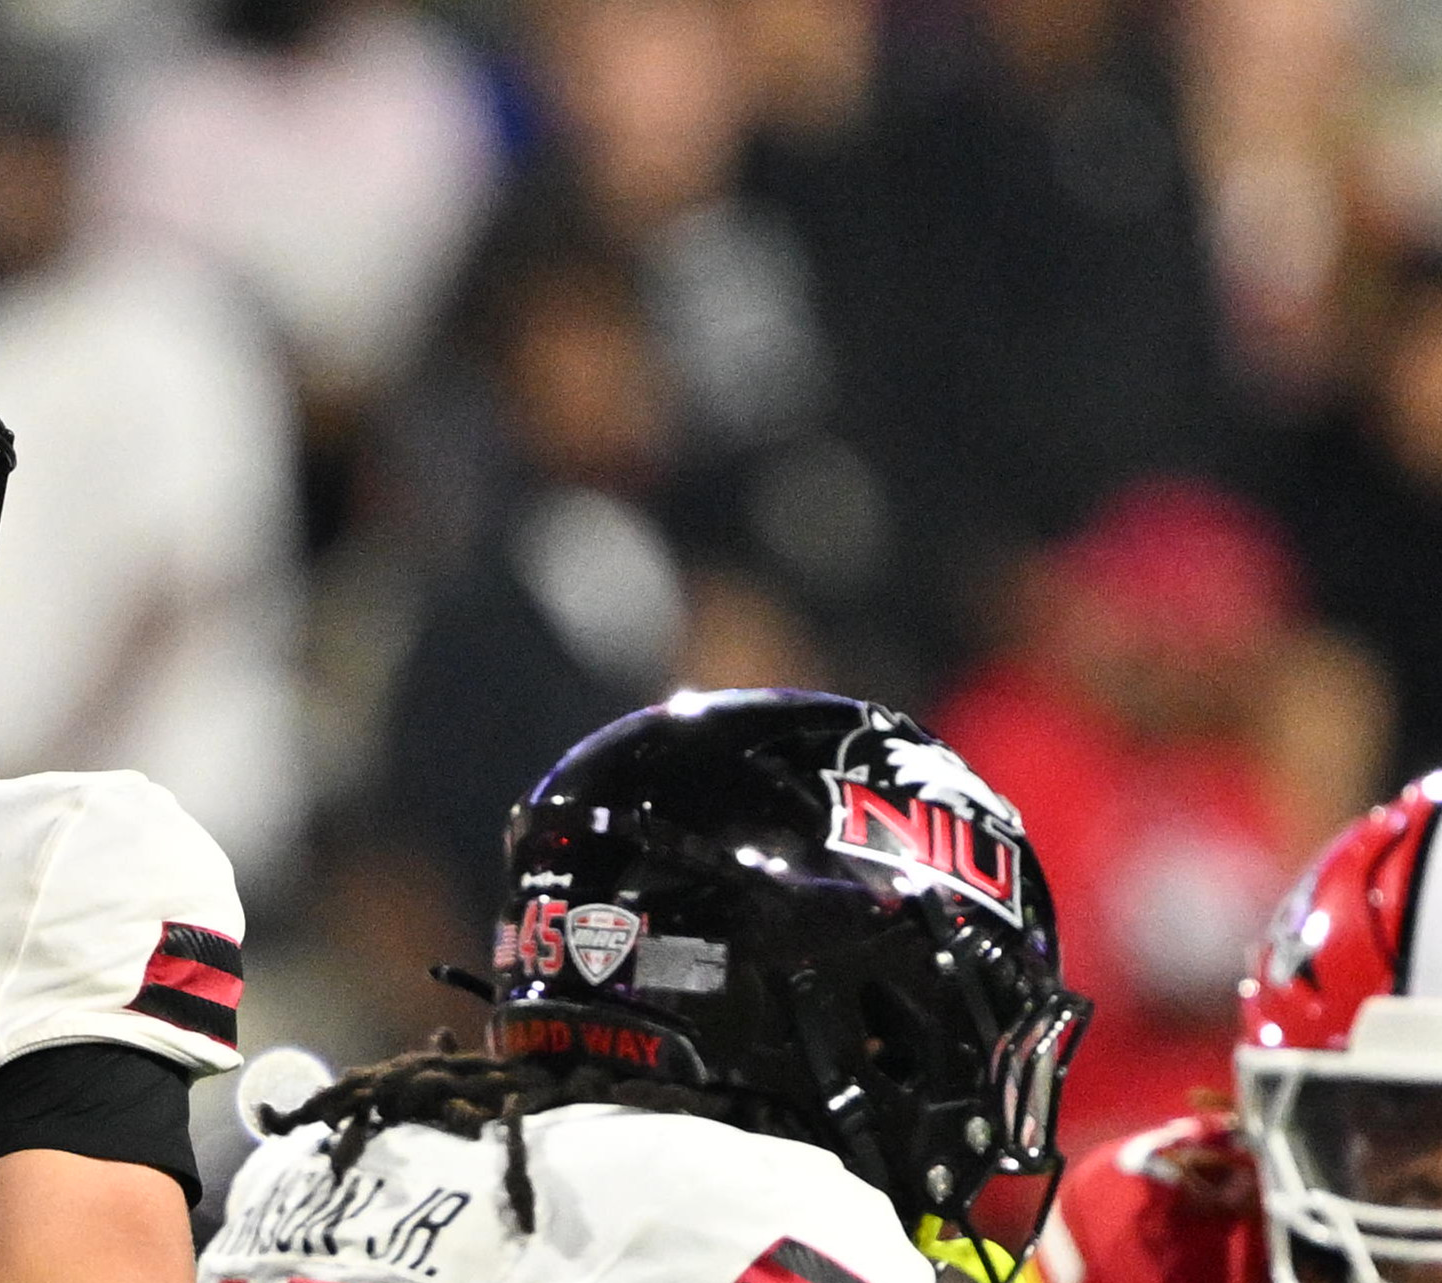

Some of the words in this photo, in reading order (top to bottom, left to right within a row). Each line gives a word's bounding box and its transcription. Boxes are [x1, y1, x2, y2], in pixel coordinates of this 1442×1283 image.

[843, 780, 1013, 900] NIU
[519, 899, 568, 976] 45
[579, 1022, 663, 1068] WAY
[366, 1188, 470, 1277] JR.
